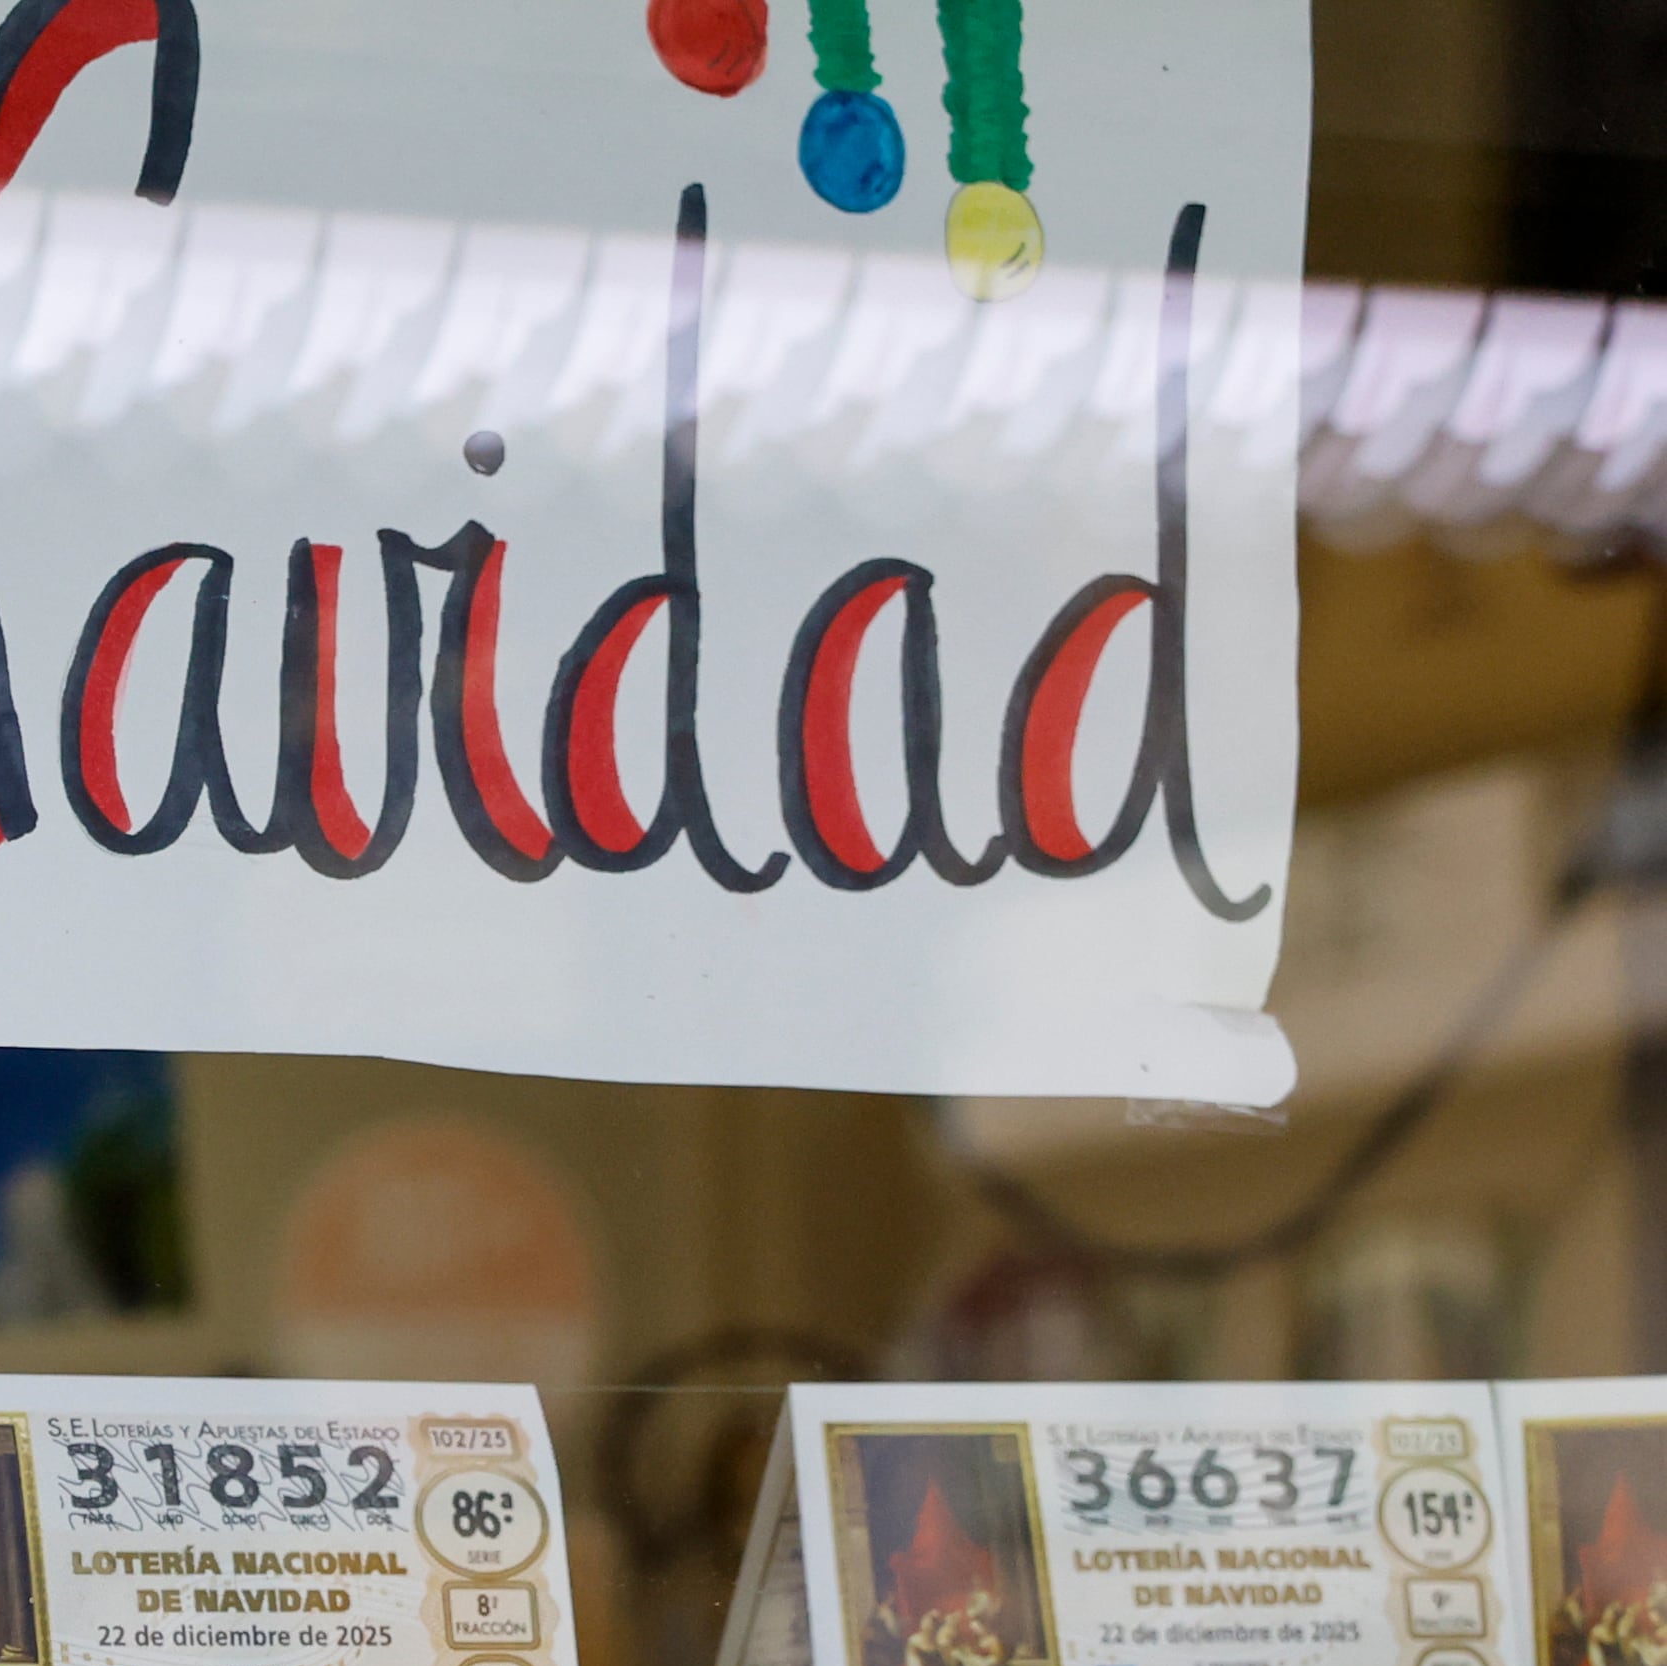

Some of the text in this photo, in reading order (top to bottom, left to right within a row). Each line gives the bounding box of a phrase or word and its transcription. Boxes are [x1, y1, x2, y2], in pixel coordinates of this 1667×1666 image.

[70, 1442, 401, 1511] 31852
[1069, 1448, 1358, 1513] 36637
[71, 1544, 409, 1577] LOTERÍA NACIONAL
[1072, 1542, 1372, 1574] LOTERÍA NACIONAL
[136, 1588, 352, 1614] DE NAVIDAD
[1131, 1583, 1324, 1609] DE NAVIDAD
